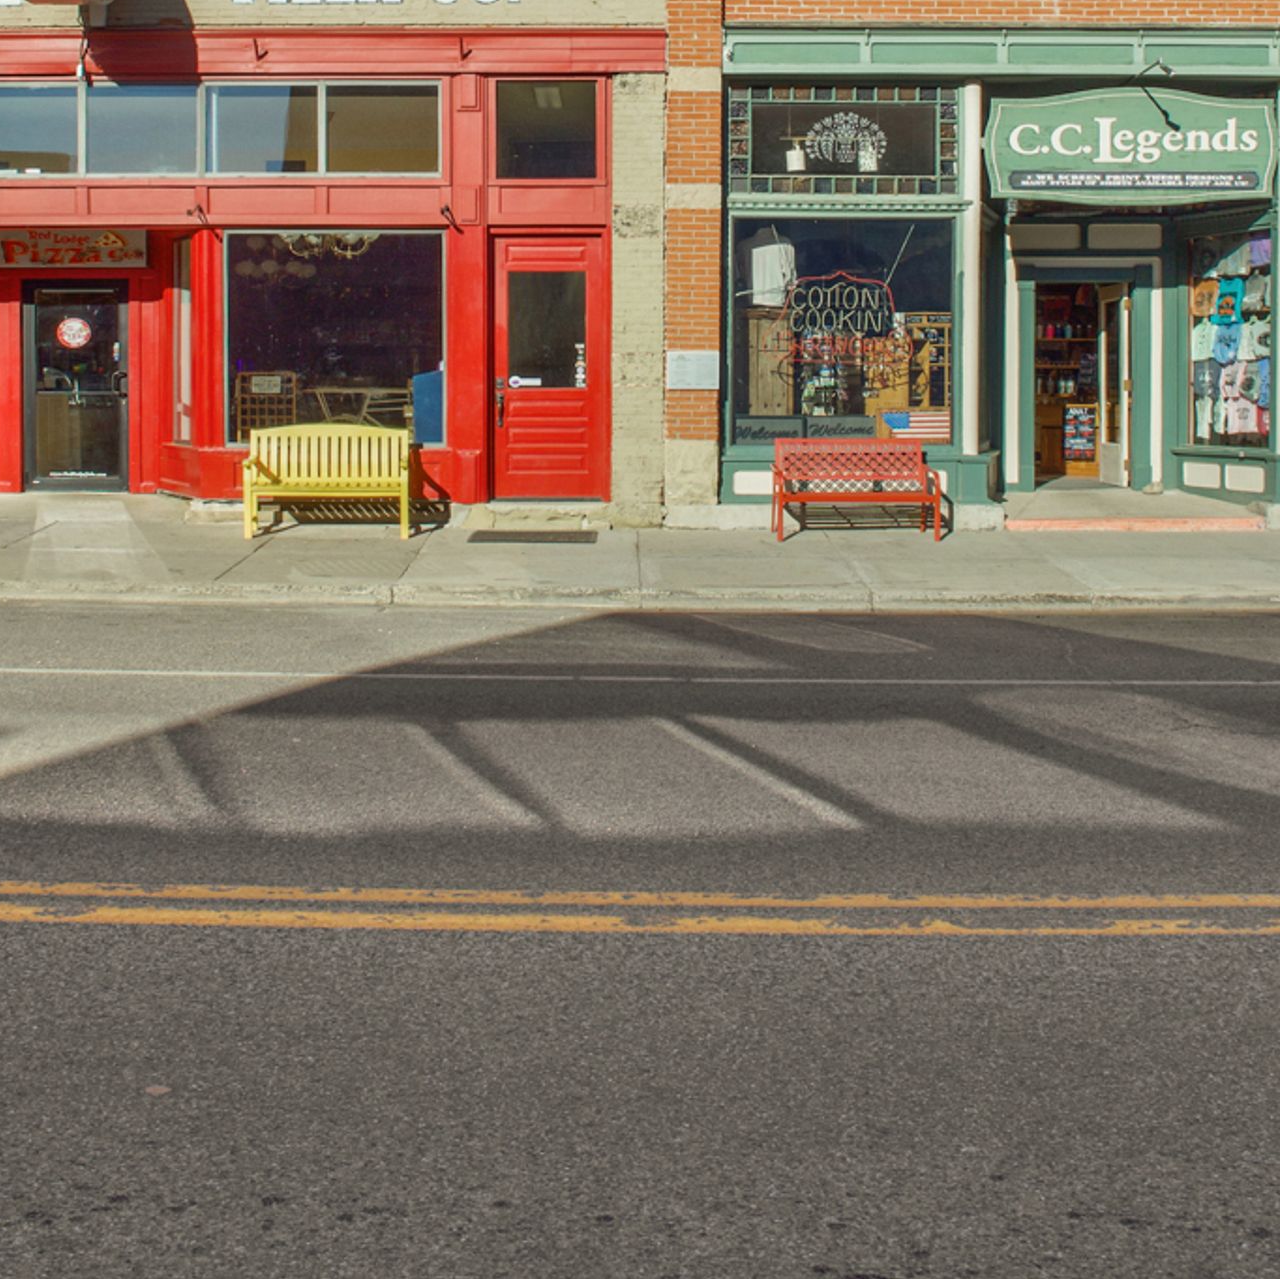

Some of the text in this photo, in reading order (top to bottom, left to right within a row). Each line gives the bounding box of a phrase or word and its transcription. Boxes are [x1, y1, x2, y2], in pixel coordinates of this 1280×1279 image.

[791, 282, 880, 310] COTTON
[735, 423, 874, 440] Welcome Welcome
